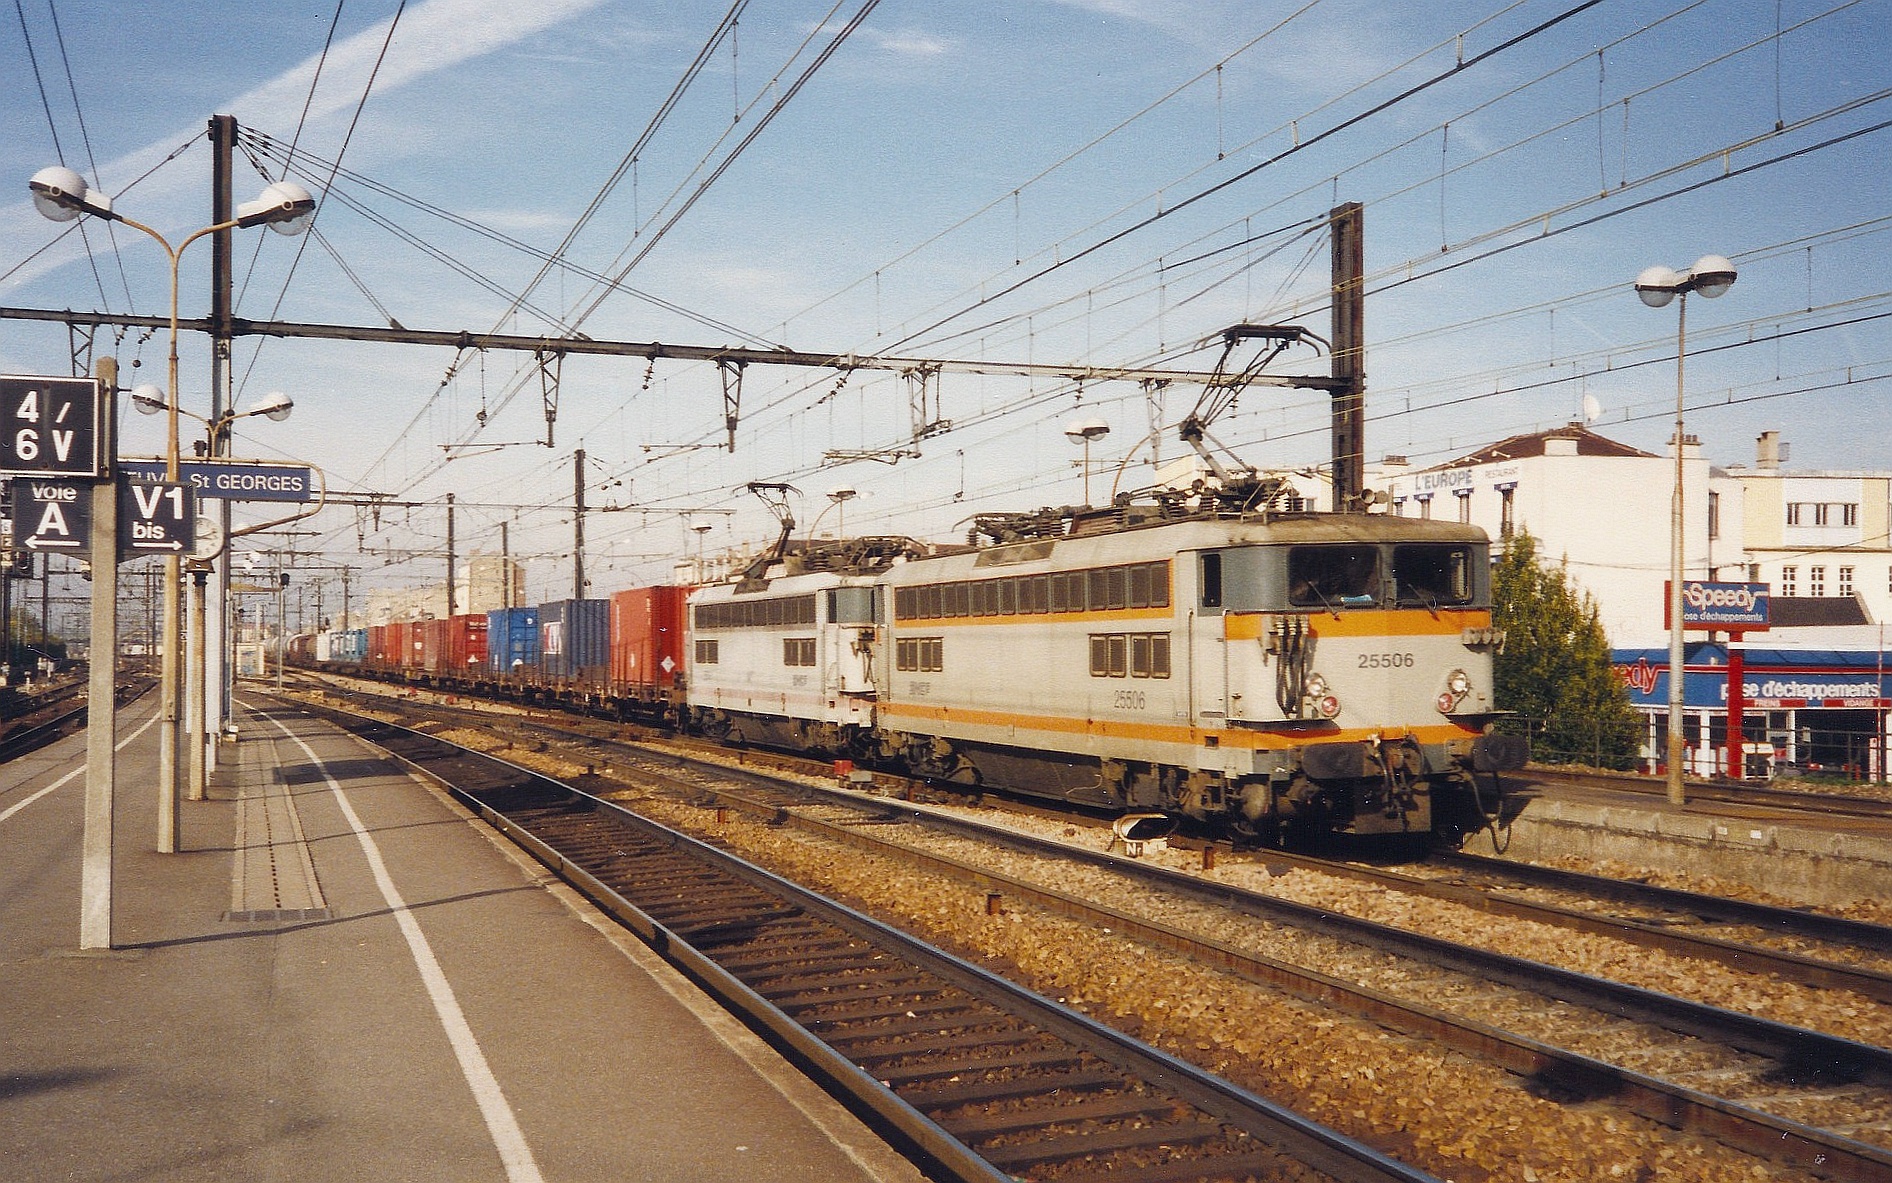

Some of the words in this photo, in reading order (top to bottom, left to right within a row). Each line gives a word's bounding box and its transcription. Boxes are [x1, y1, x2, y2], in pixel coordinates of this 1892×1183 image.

[16, 390, 39, 423] 4
[15, 429, 39, 461] 6
[51, 430, 74, 462] V
[190, 473, 209, 490] St
[216, 475, 303, 492] GEORGES
[1415, 469, 1473, 490] L'EUROPE
[31, 481, 77, 500] Voie
[132, 486, 183, 520] V1
[36, 502, 69, 535] A
[132, 521, 165, 539] bis
[1689, 582, 1758, 612] Speedy
[1684, 613, 1698, 621] ose
[1700, 611, 1764, 622] d'échappements
[1358, 653, 1414, 668] 25506
[1614, 657, 1658, 695] edy
[1113, 690, 1145, 710] 25506
[1720, 682, 1759, 700] pse
[1762, 680, 1879, 701] d'échappements
